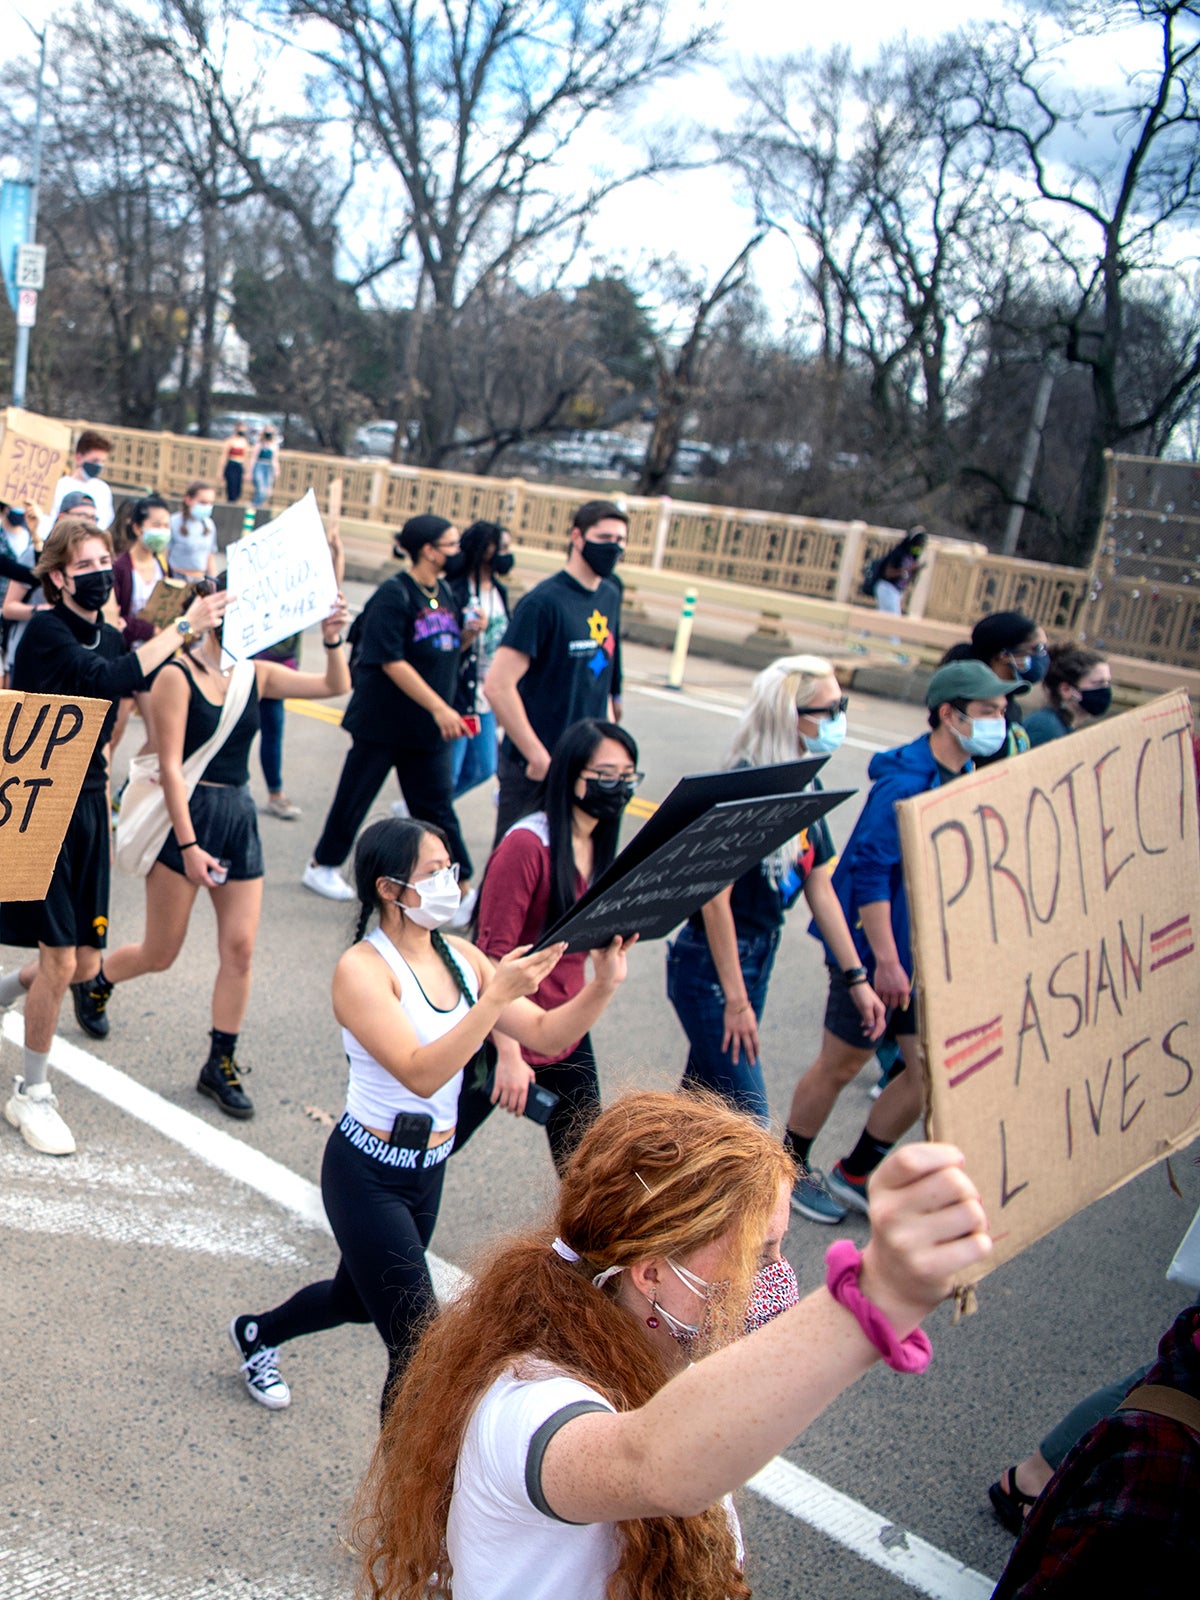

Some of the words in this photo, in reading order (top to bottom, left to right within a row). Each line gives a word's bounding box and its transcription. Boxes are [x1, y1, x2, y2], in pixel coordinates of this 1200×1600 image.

[11, 438, 61, 476] STOP
[3, 474, 50, 506] HATE
[2, 701, 84, 770] UP
[657, 843, 687, 864] A
[688, 828, 774, 858] VIRUS
[930, 724, 1191, 983] PROTECT
[1015, 913, 1144, 1086] ASIAN
[340, 1113, 421, 1169] GYMSHARK
